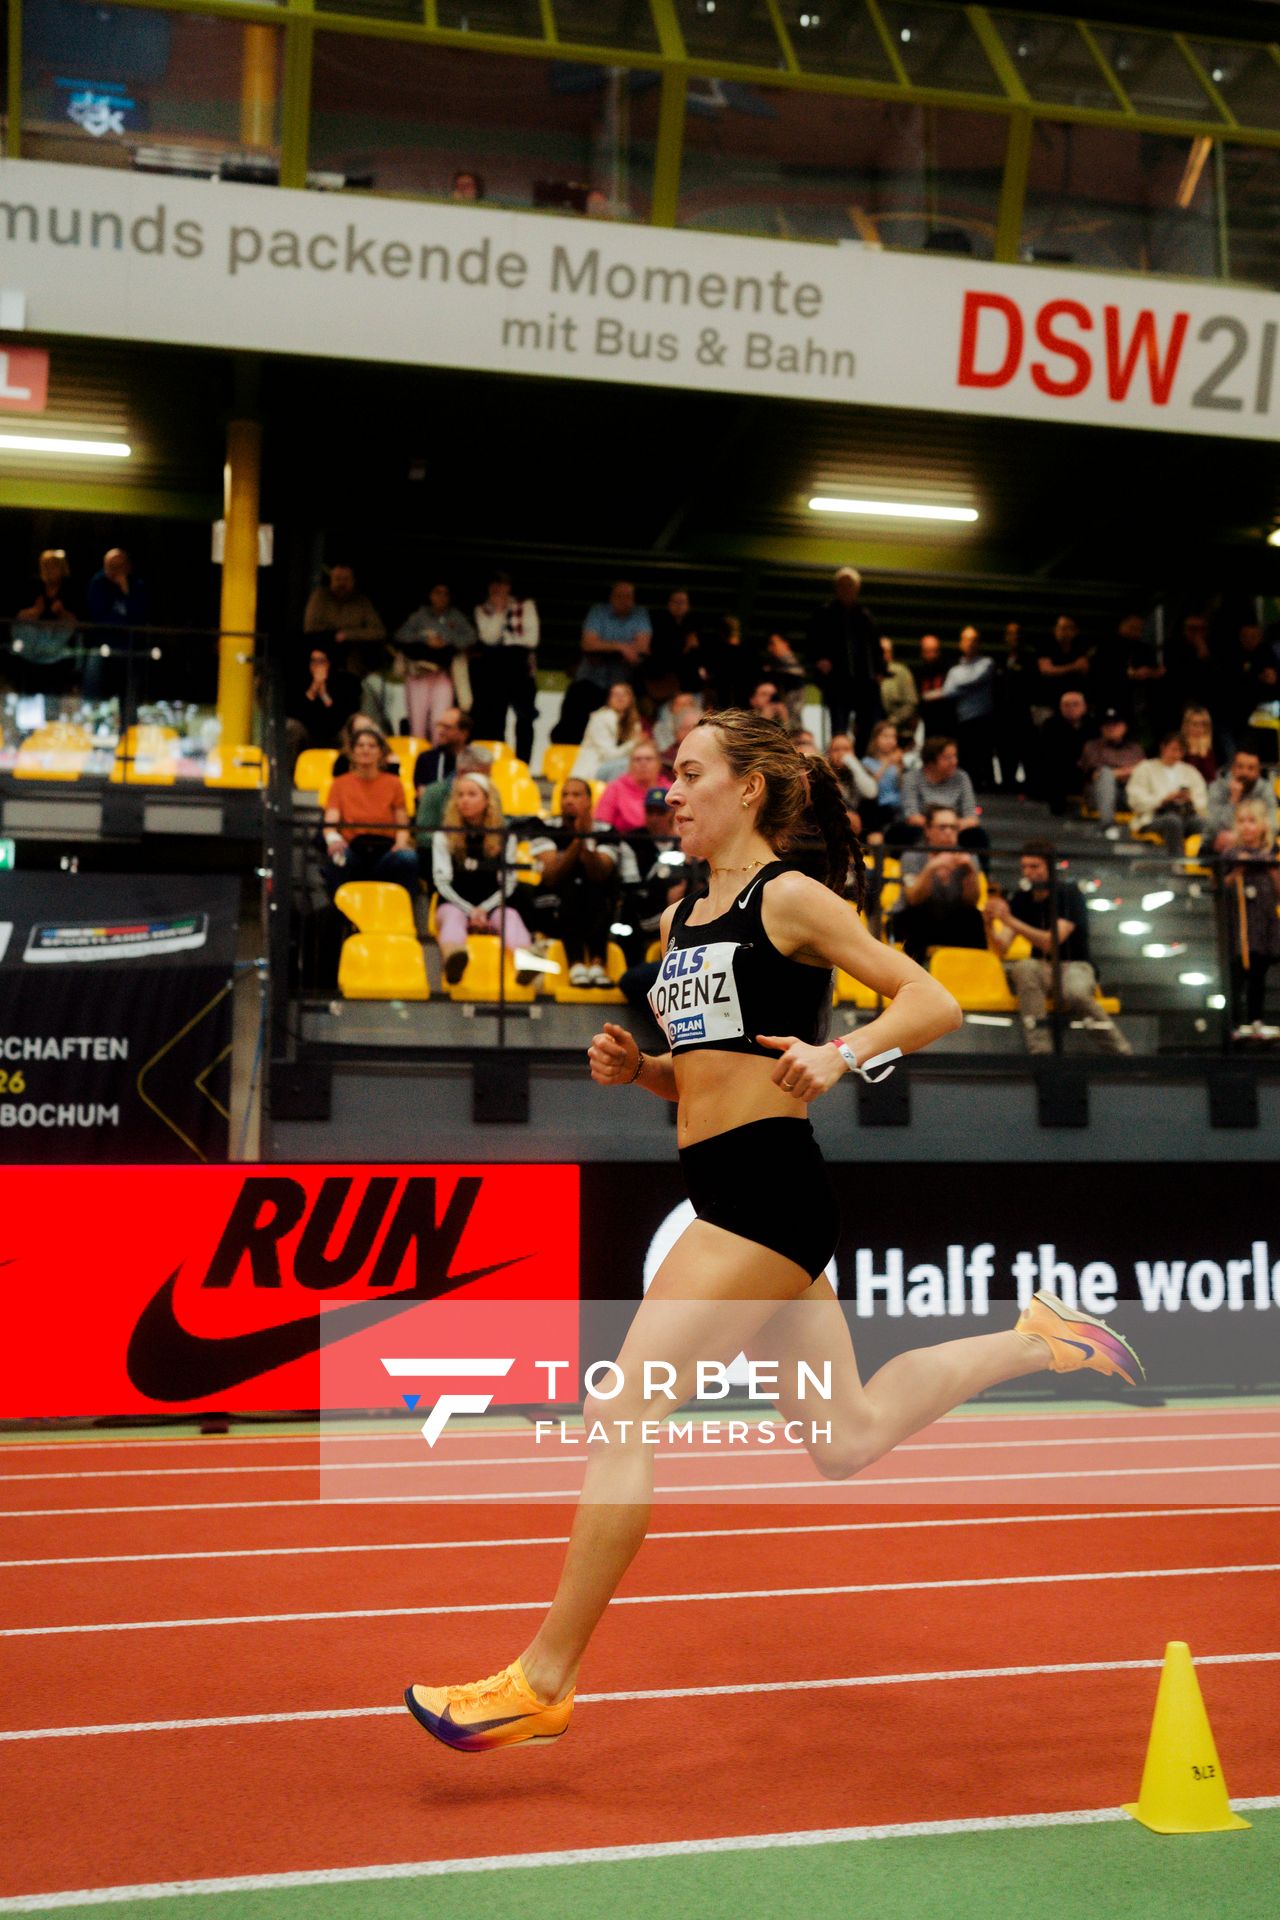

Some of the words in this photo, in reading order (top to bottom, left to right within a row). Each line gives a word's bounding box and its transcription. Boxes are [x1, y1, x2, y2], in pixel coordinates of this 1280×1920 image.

[228, 223, 529, 290] packende
[550, 245, 824, 318] Momente
[502, 314, 578, 353] mit
[595, 318, 680, 362] Bus
[696, 327, 728, 368] &
[745, 332, 857, 379] Bahn
[649, 972, 731, 1019] LORENZ
[0, 1036, 129, 1060] CHAFTEN
[677, 1019, 703, 1033] PLAN
[0, 1103, 119, 1127] BOCHUM
[201, 1177, 484, 1290] RUN
[855, 1243, 995, 1318] Half
[1012, 1243, 1118, 1313] the
[1135, 1240, 1280, 1313] worl
